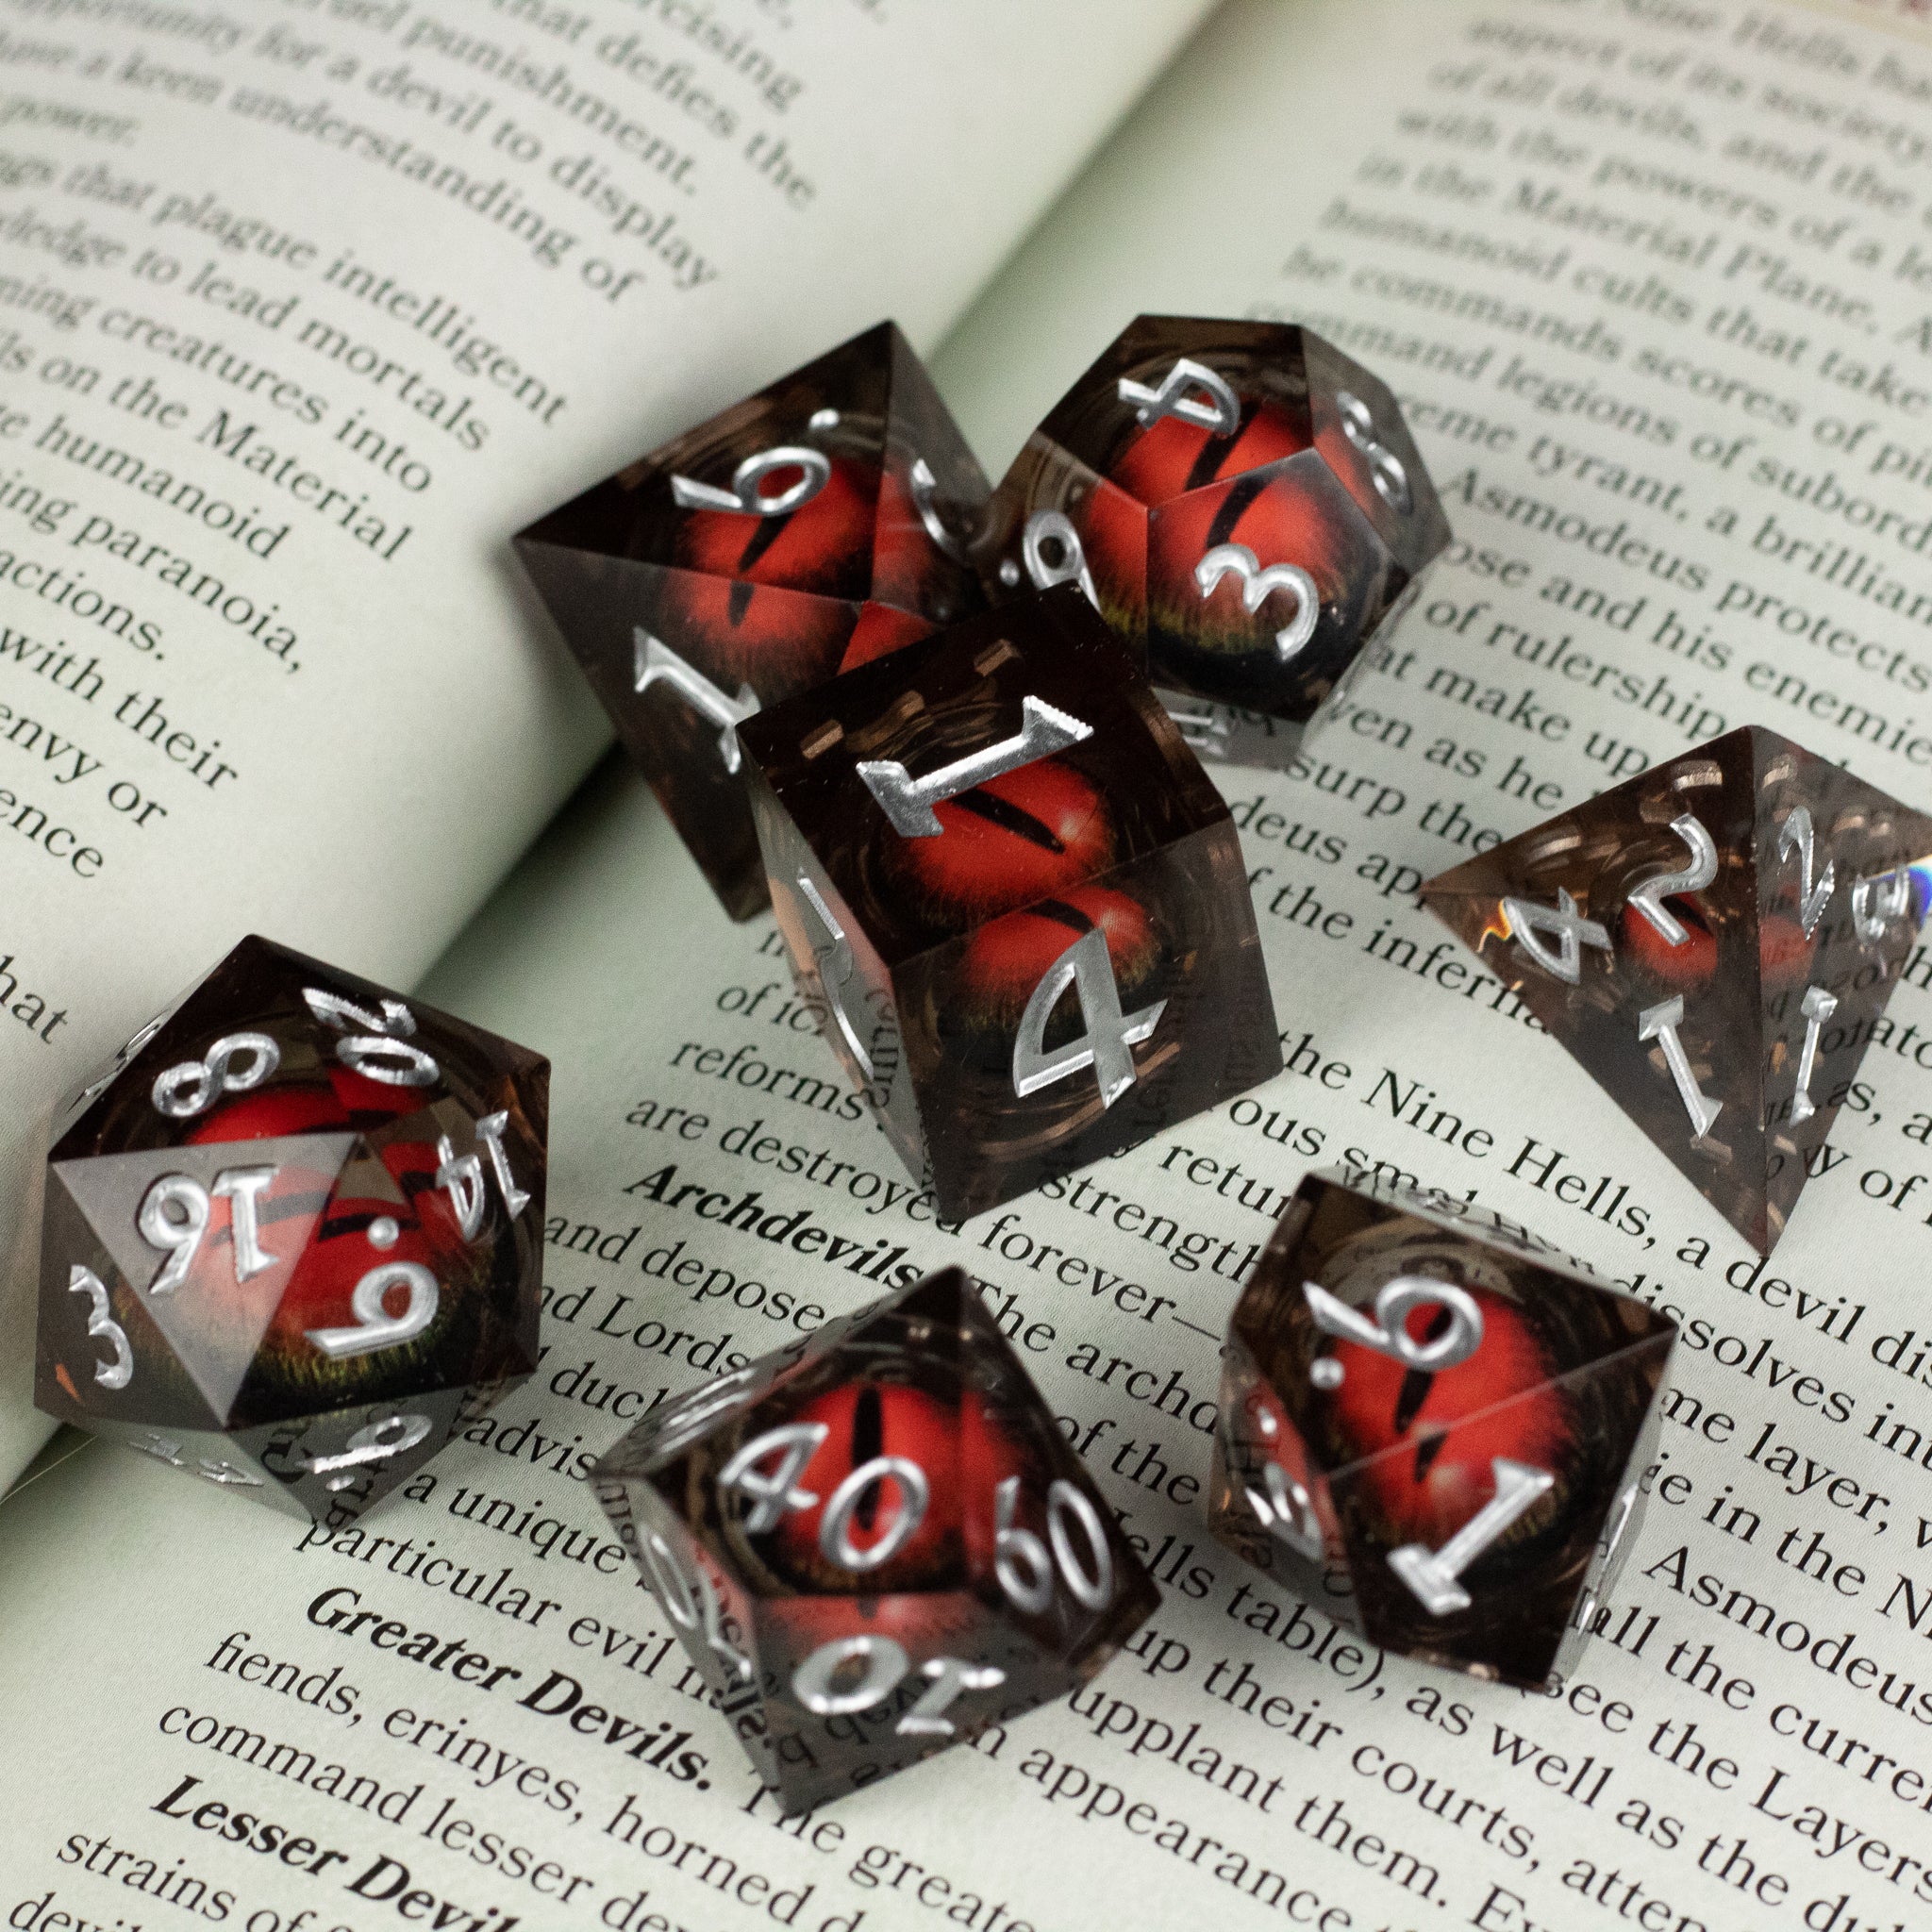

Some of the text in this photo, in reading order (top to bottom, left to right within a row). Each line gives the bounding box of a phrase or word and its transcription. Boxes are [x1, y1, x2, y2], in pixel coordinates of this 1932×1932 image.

[366, 62, 492, 146] devil
[490, 118, 543, 170] to
[549, 153, 719, 291] display
[402, 15, 696, 196] punishment.
[596, 31, 816, 208] defies the
[1721, 134, 1828, 183] and
[1829, 161, 1915, 218] the
[229, 88, 577, 269] understanding
[580, 254, 645, 306] of
[1396, 108, 1885, 269] with the powers of a
[1412, 160, 1496, 207] the
[1502, 175, 1720, 269] Material
[132, 247, 491, 452] to lead mortals
[151, 191, 319, 269] plague
[324, 247, 568, 428] intelligent
[1281, 242, 1879, 455] he commands scores of
[1320, 192, 1930, 418] humanoid cults that take
[41, 355, 415, 562] on the Material
[99, 307, 434, 495] creatures into
[1117, 358, 1241, 437] 4
[1335, 391, 1415, 516] 8
[1495, 356, 1760, 470] legions of
[34, 413, 295, 560] humanoid
[1526, 431, 1689, 522] tyrant,
[1705, 506, 1740, 539] a
[70, 514, 302, 674] paranoia,
[1193, 541, 1321, 662] 3
[1440, 466, 1932, 694] Asmodeus protects
[1541, 571, 1647, 634] and
[1654, 608, 1733, 673] his
[0, 626, 239, 791] with their
[1424, 596, 1729, 743] of rulership
[1427, 659, 1651, 782] make up
[108, 776, 169, 829] or
[856, 694, 1094, 839] 1
[1424, 736, 1567, 811] as he
[1268, 885, 1355, 941] the
[1502, 886, 1614, 987] 4
[1628, 812, 1718, 947] 2
[1779, 805, 1836, 941] 2
[151, 1031, 281, 1119] 8
[1012, 925, 1172, 1110] 4
[1639, 994, 1724, 1140] 1
[1791, 984, 1840, 1126] 1
[625, 1088, 710, 1141] are
[1363, 1068, 1495, 1158] Nine
[1502, 1136, 1656, 1254] Hells,
[1675, 1234, 1712, 1270] a
[1724, 1256, 1867, 1346] devil
[1859, 1166, 1930, 1212] of
[68, 1264, 134, 1391] 3
[668, 1036, 864, 1120] reforms
[1701, 1485, 1762, 1545] in
[1775, 1526, 1867, 1596] the
[545, 1216, 643, 1265] and
[1110, 1439, 1201, 1507] the
[1647, 1717, 1741, 1791] the
[718, 1421, 930, 1573] 40
[1386, 1455, 1556, 1618] 1
[1744, 1422, 1892, 1537] layer,
[293, 1521, 688, 1680] particular evil
[1663, 1635, 1757, 1712] the
[305, 1585, 523, 1691] Greater
[516, 1668, 712, 1792] Devils.
[404, 1469, 438, 1505] a
[448, 1485, 628, 1577] unique
[1018, 1744, 1354, 1932] appearance
[1224, 1581, 1387, 1704] table),
[1405, 1683, 1476, 1739] as
[1489, 1721, 1615, 1810] well
[1614, 1797, 1686, 1853] as
[1697, 1833, 1790, 1907] the
[151, 1774, 349, 1878] Lesser
[158, 1705, 594, 1904] command lesser
[204, 1630, 815, 1926] fiends, erinyes, horned
[1204, 1655, 1344, 1753] their
[1351, 1743, 1541, 1874] courts,
[57, 1832, 237, 1924] strains
[1292, 1796, 1448, 1909] them.
